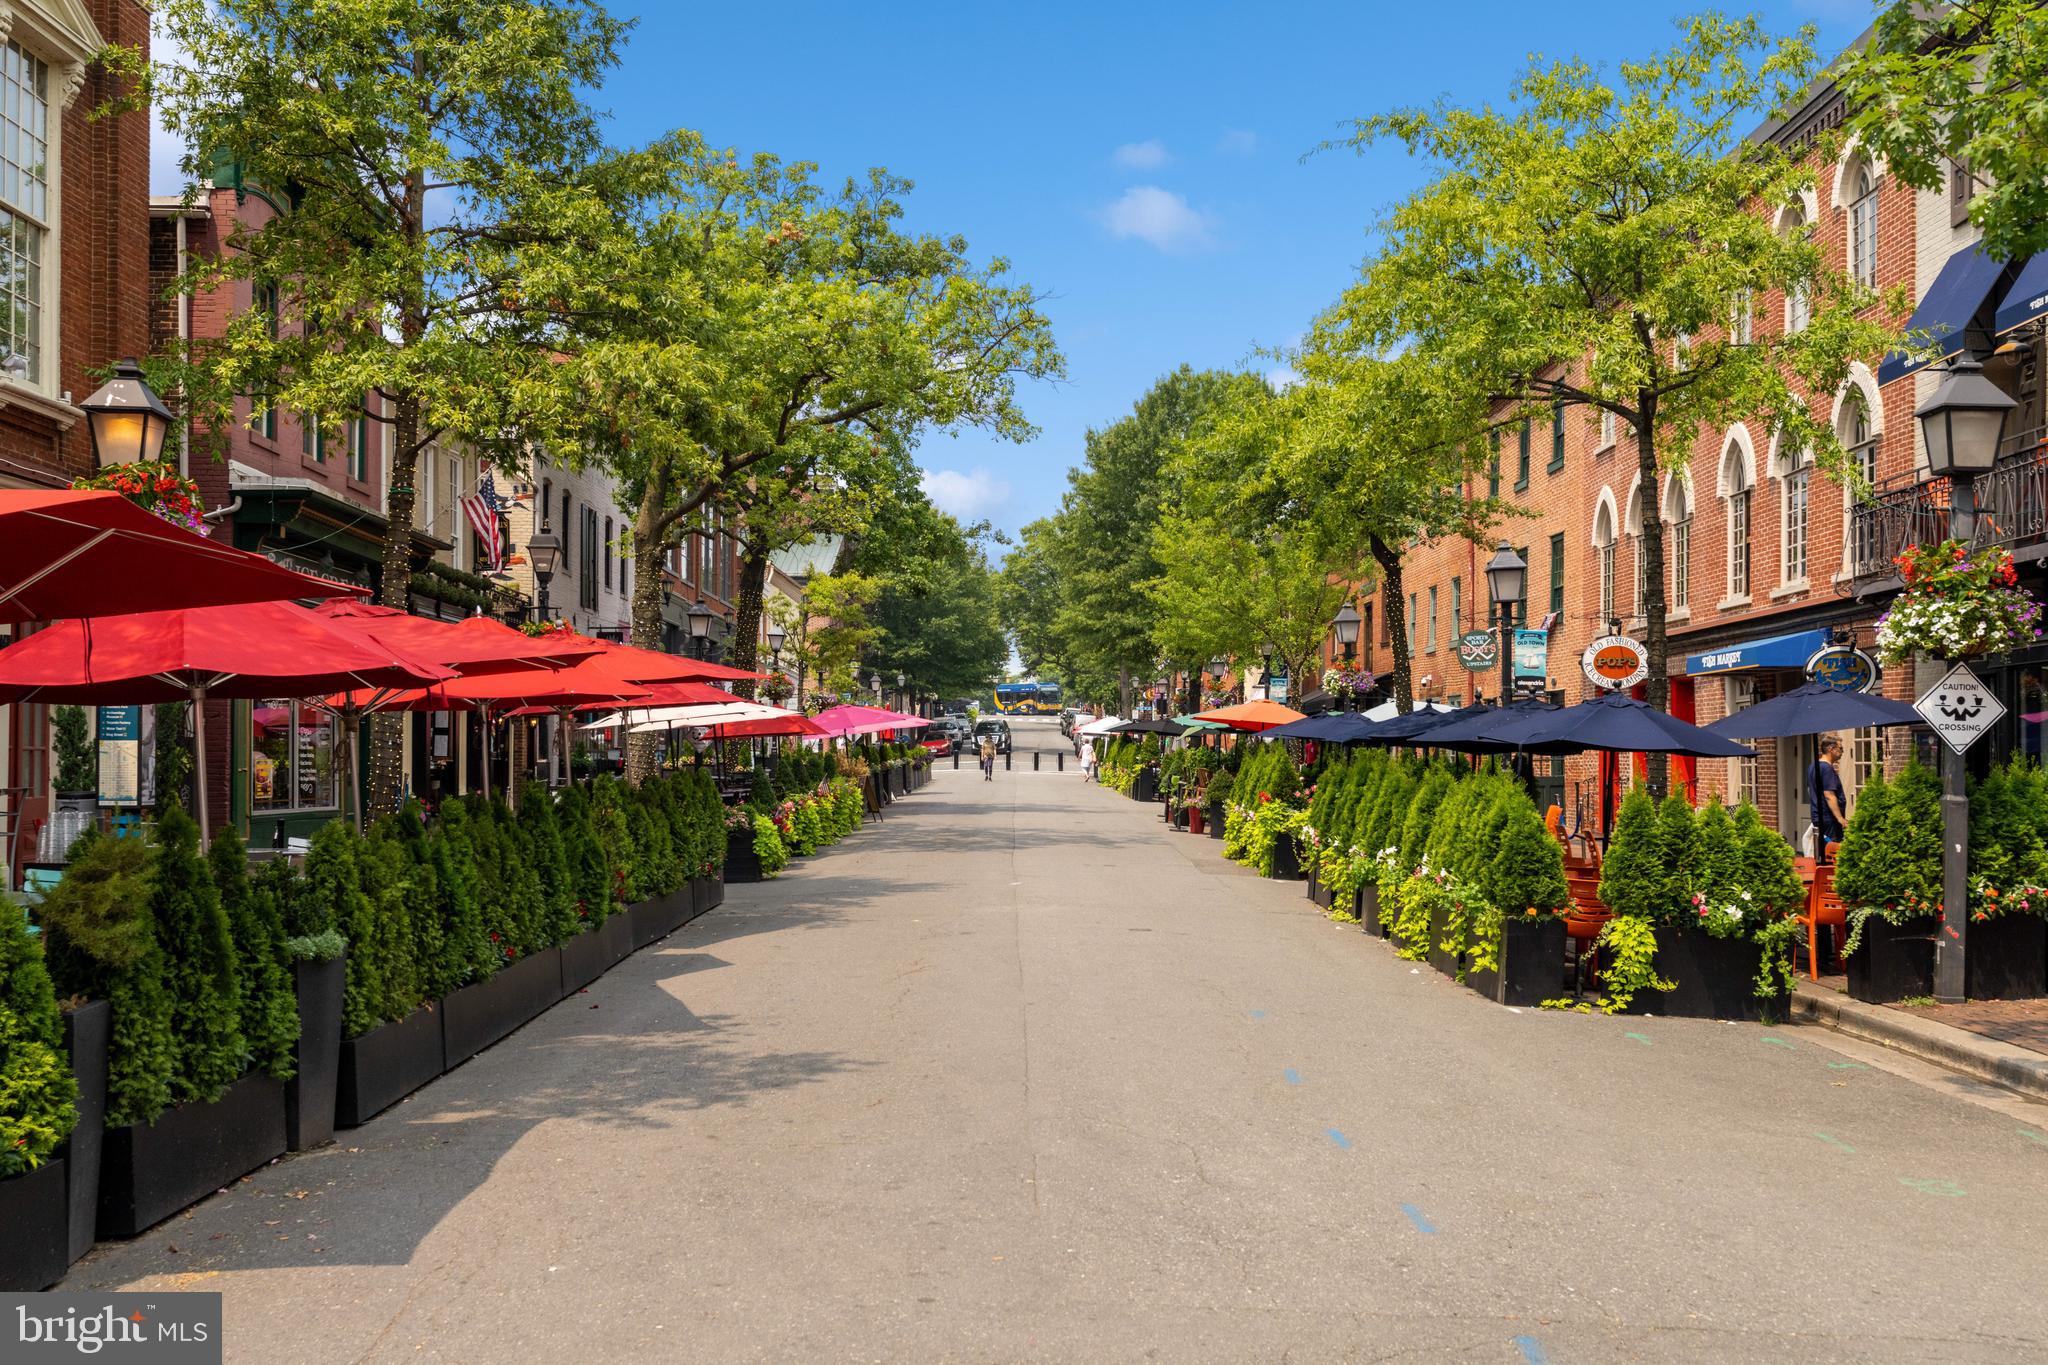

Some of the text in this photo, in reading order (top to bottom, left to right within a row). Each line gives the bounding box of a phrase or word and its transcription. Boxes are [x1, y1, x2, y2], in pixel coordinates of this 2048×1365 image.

[1589, 637, 1645, 656] OLD FASHIONED
[1620, 662, 1648, 687] OMPANY
[1942, 683, 1979, 691] CAUTION!
[1938, 723, 1981, 732] CROSSING
